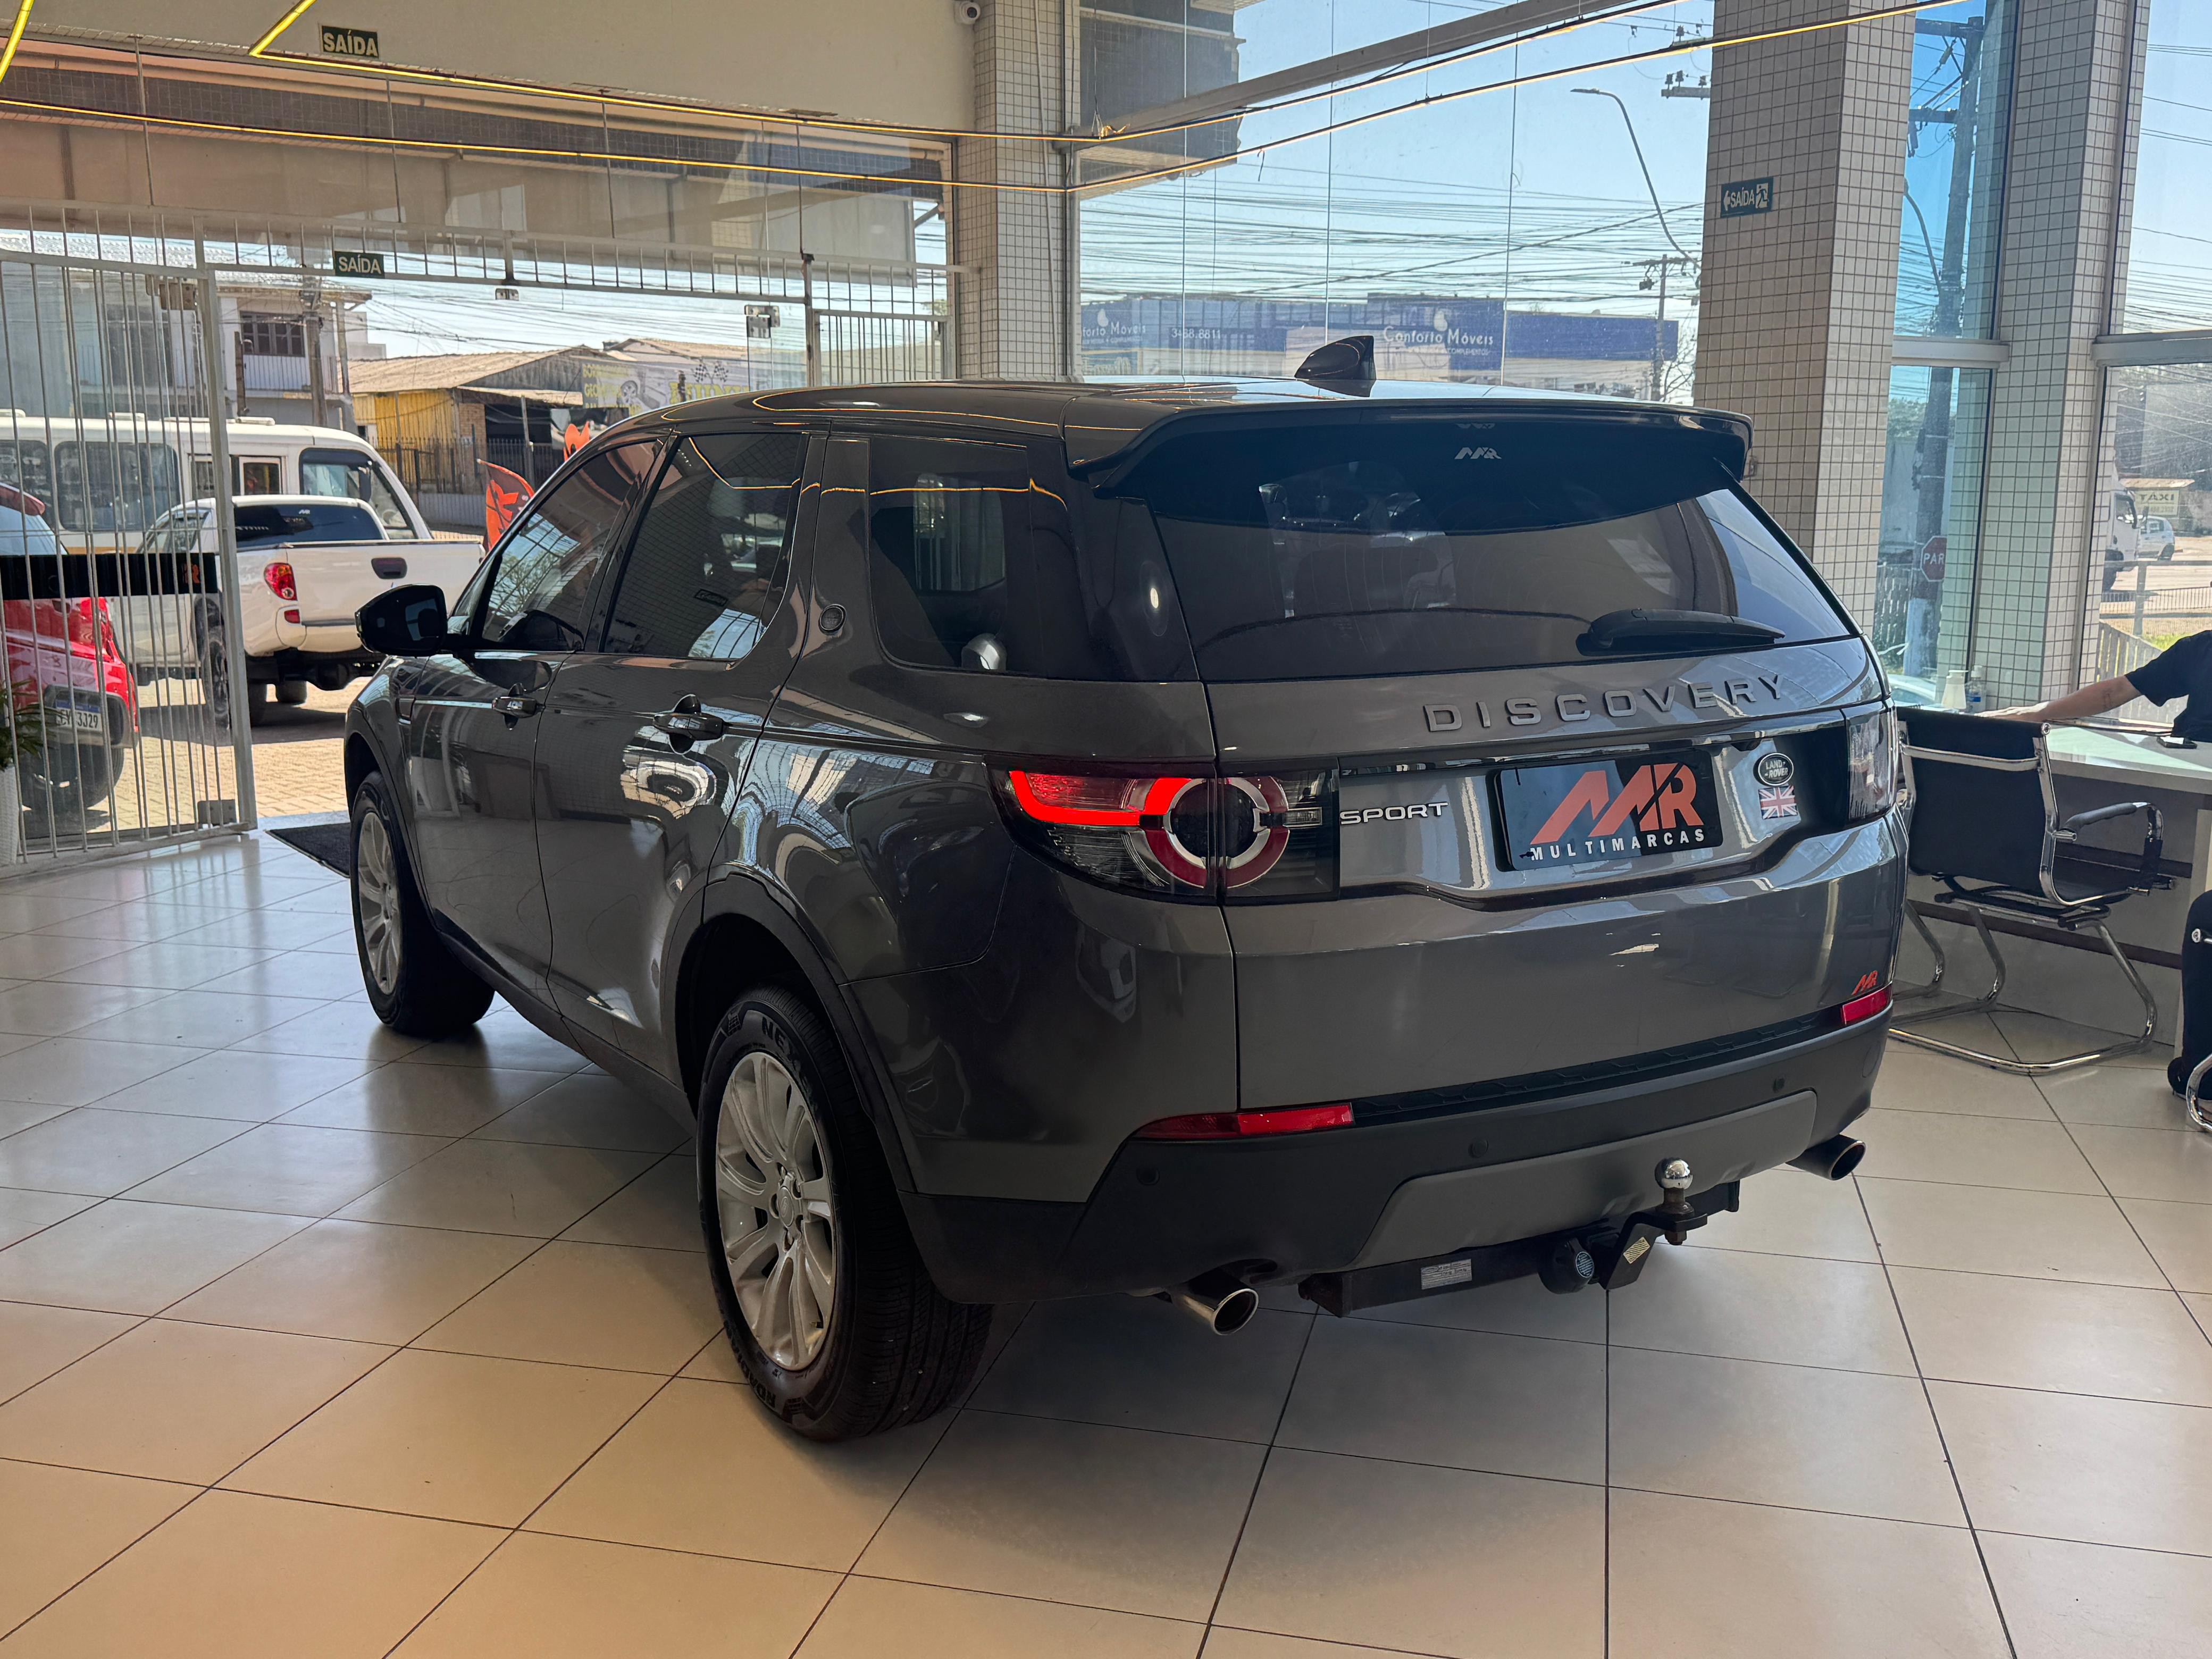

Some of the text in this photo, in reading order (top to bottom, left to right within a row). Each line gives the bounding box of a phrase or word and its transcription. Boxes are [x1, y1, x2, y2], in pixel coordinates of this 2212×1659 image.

[323, 30, 378, 56] SAÍDA
[1730, 187, 1755, 208] SAÍDA
[339, 254, 381, 274] SAÍDA
[1384, 325, 1493, 345] Conforto Móveis
[1923, 553, 1945, 564] PAR
[1423, 675, 1784, 732] DISCOVERY
[1765, 759, 1783, 770] LAND
[1769, 767, 1788, 778] ROVER
[1339, 802, 1448, 825] SPORT
[1530, 828, 1704, 861] MULTIMARCAS
